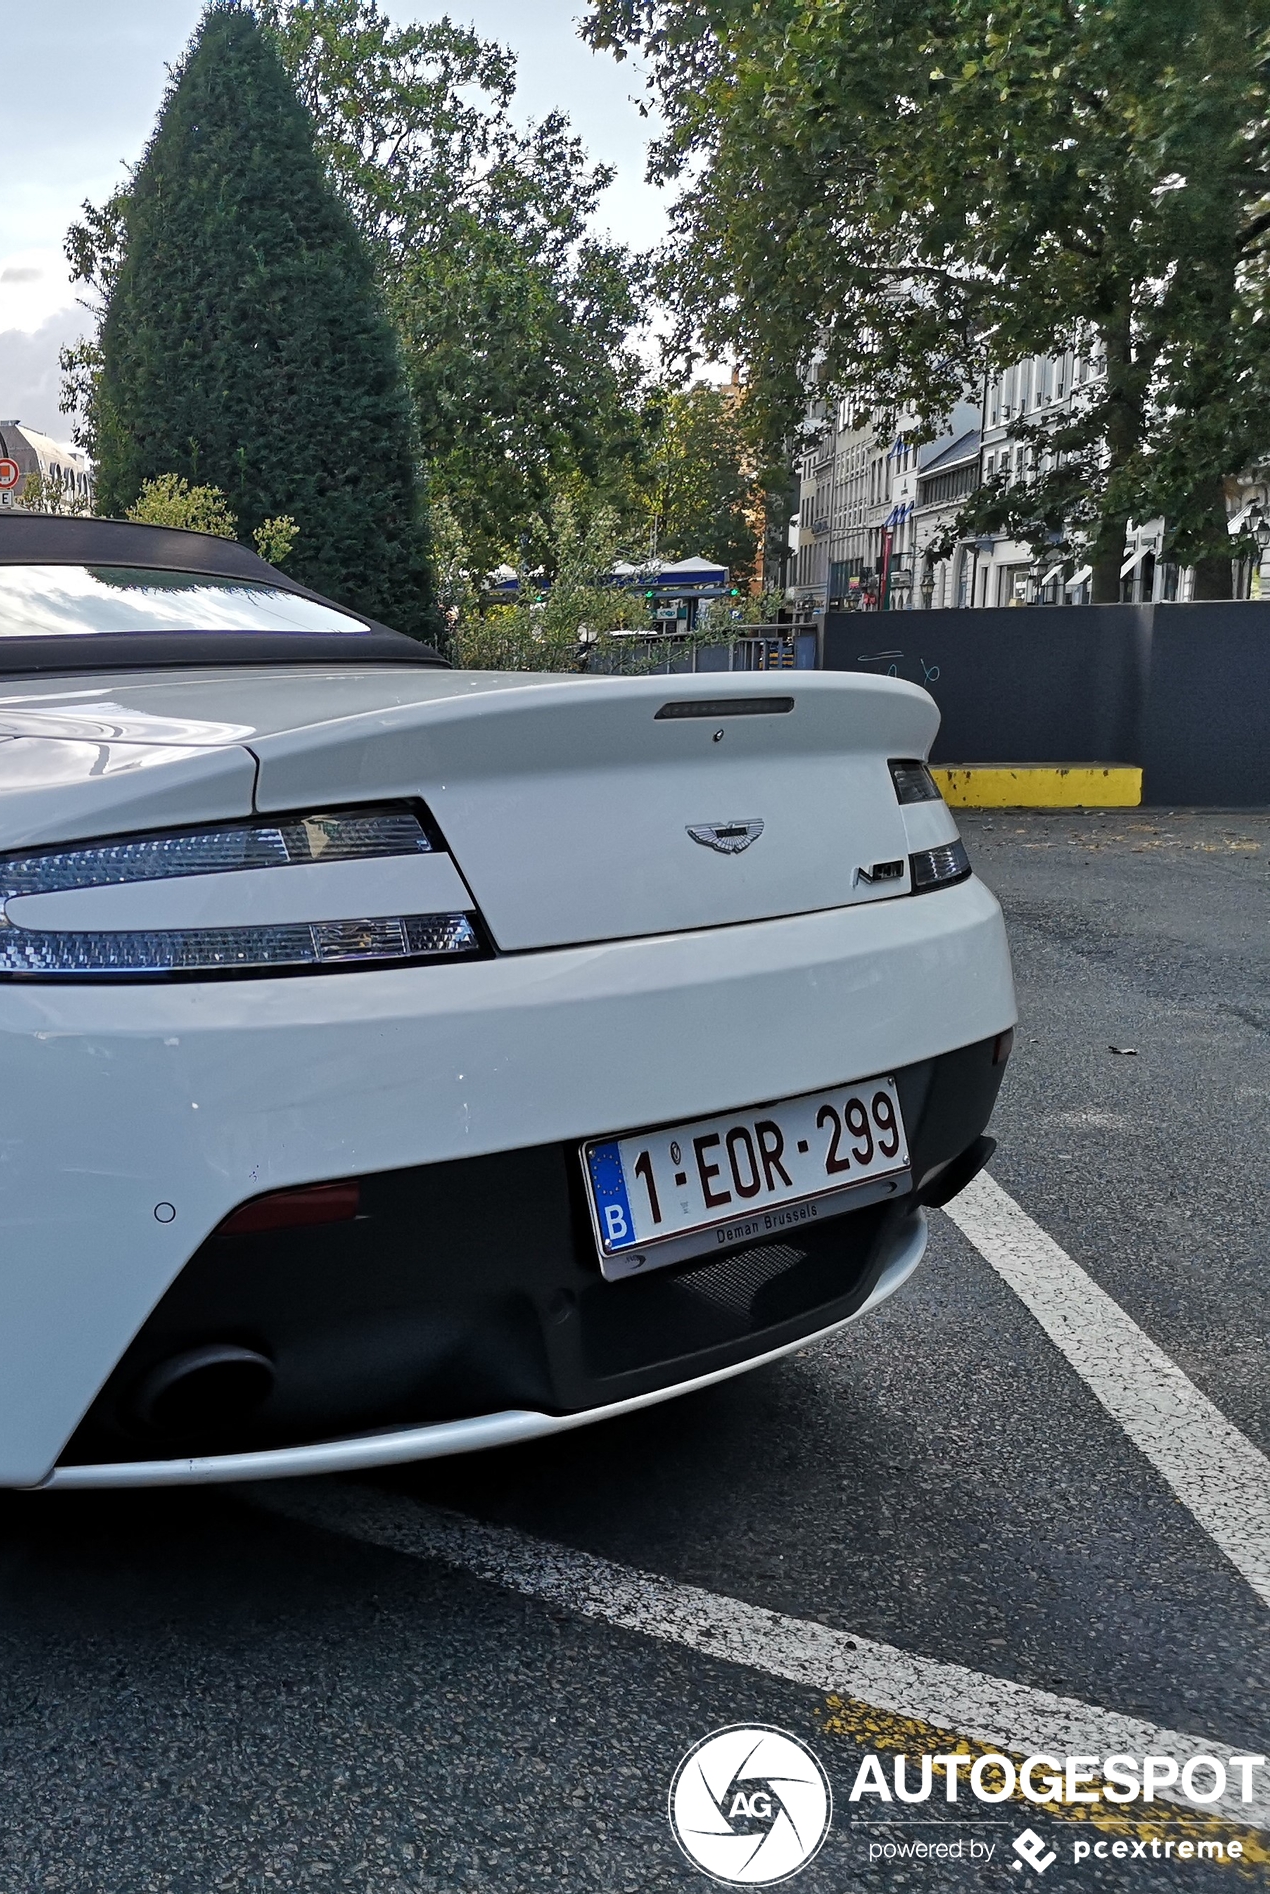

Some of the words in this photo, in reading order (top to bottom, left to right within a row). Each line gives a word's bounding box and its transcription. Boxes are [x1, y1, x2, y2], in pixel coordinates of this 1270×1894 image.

[2, 492, 10, 505] E
[604, 1203, 629, 1240] B
[716, 1222, 760, 1245] Deman
[764, 1203, 819, 1231] Brussels
